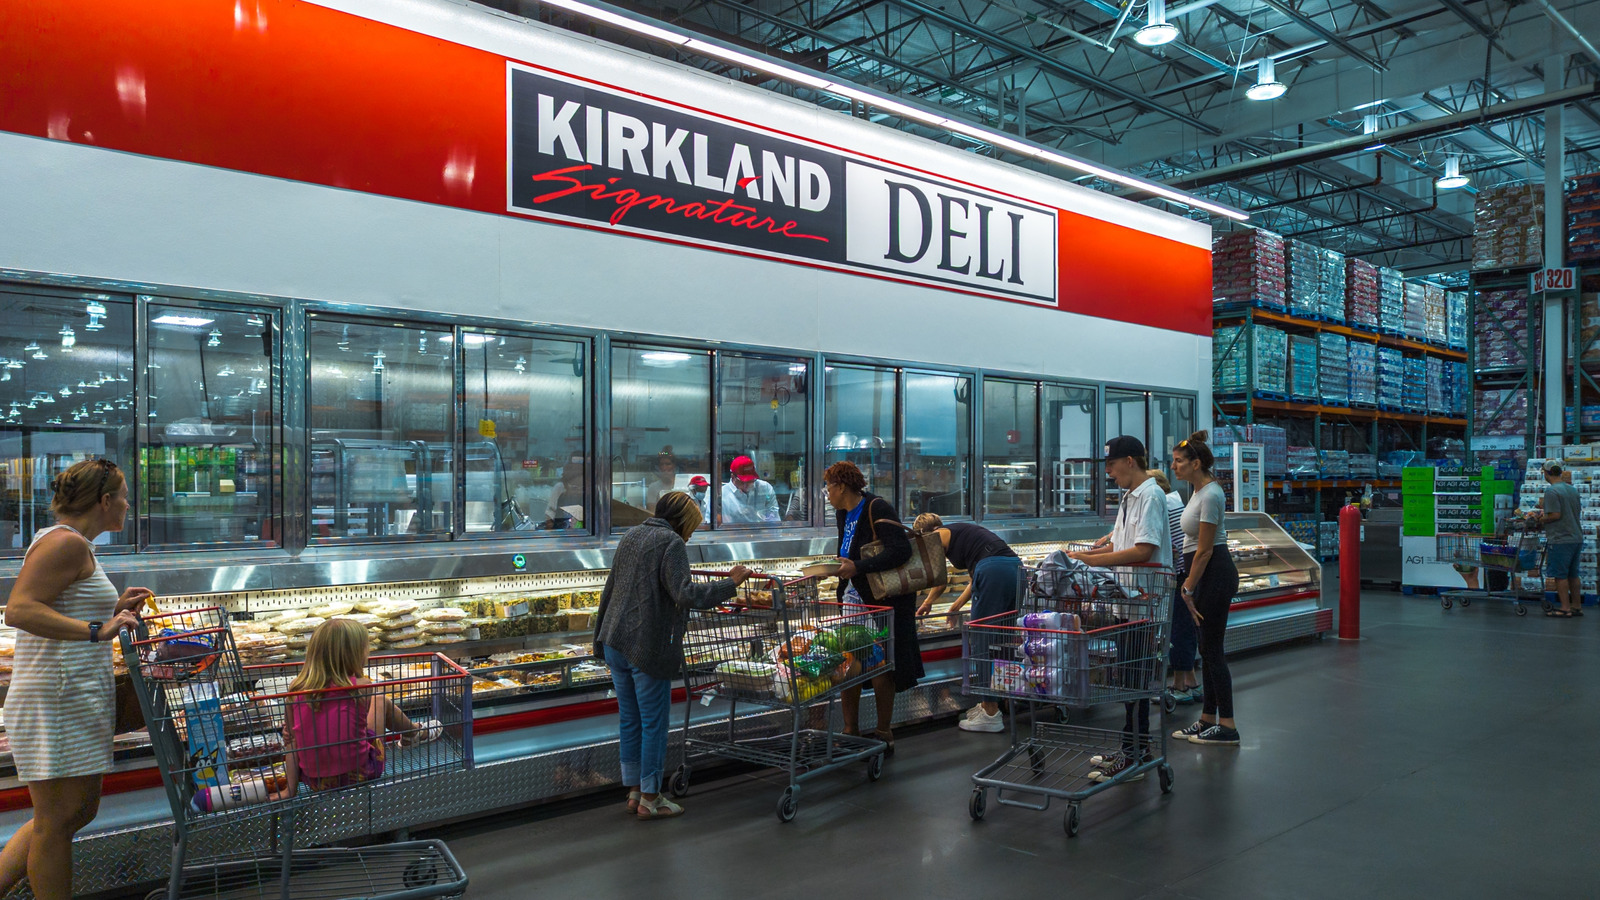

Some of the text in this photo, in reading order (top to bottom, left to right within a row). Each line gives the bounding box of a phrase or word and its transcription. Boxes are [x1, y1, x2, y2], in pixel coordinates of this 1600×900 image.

[538, 93, 831, 212] KIRKLAND
[532, 164, 829, 243] Signature
[884, 179, 1024, 285] DELI
[1547, 269, 1572, 288] 320
[1406, 556, 1424, 564] AG1
